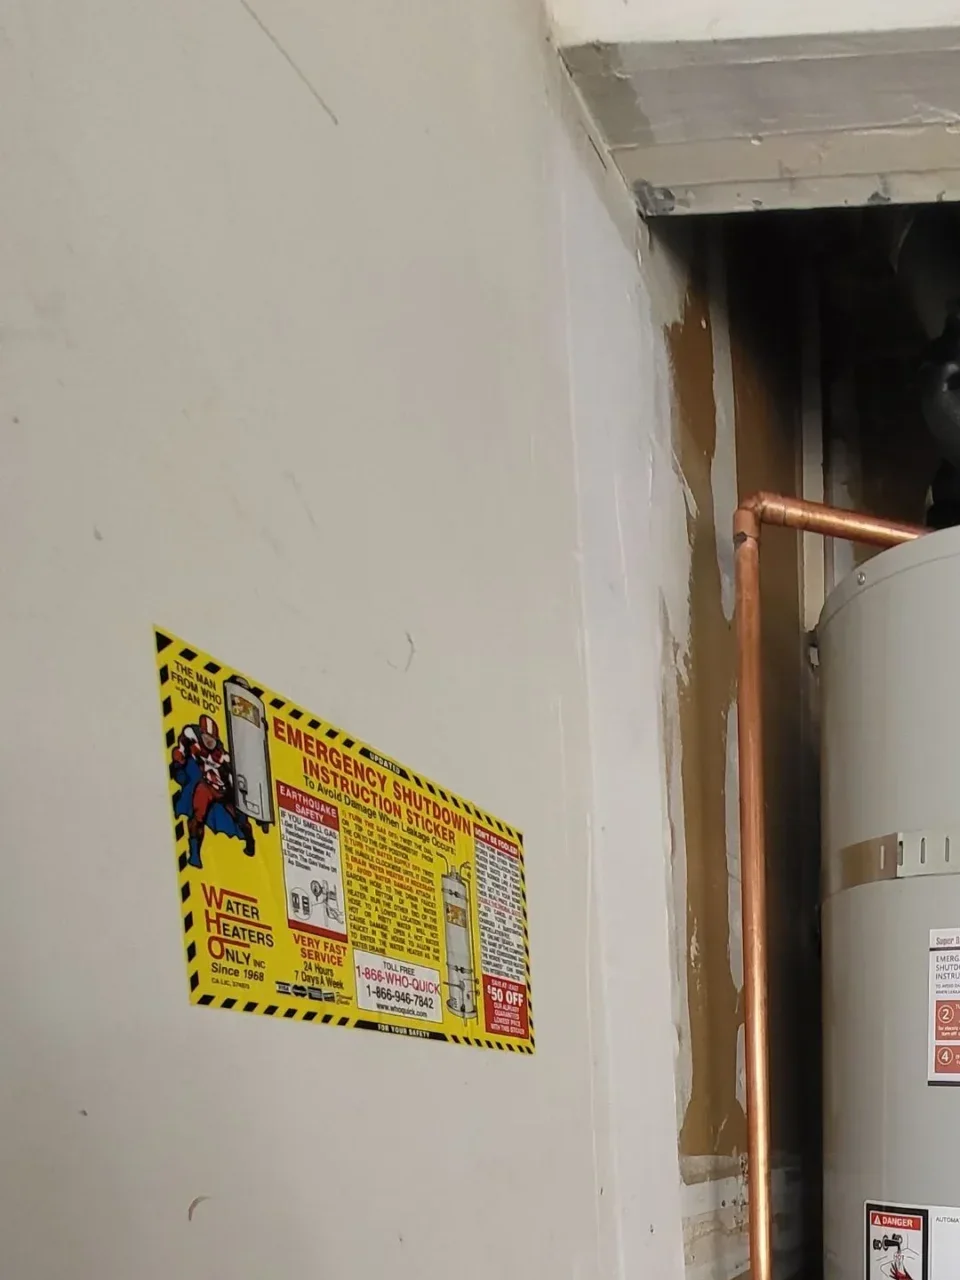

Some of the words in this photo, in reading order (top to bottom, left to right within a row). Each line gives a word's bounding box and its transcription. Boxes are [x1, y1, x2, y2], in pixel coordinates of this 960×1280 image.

[173, 660, 193, 679] THE
[196, 672, 216, 691] MAN
[171, 671, 198, 693] FROM
[200, 684, 222, 705] WHO
[369, 752, 400, 774] UPDATED
[273, 716, 387, 792] EMERGENCY
[392, 780, 472, 836] SHUTDOWN
[280, 785, 336, 818] EARTHQUAKE
[303, 756, 402, 819] INSTRUCTION
[406, 810, 456, 845] STICKER
[304, 774, 314, 789] To
[317, 782, 342, 801] Avoid
[344, 796, 377, 820] Damage
[379, 811, 400, 830] When
[402, 820, 430, 844] Leakage
[281, 810, 286, 818] IF
[288, 813, 301, 825] YOU
[303, 818, 322, 834] SMELL
[296, 803, 324, 822] SAFETY
[490, 836, 497, 845] BE
[200, 882, 260, 920] WATER
[204, 909, 274, 948] HEATERS
[207, 936, 250, 966] ONLY
[253, 958, 266, 968] INC
[292, 933, 320, 949] VERY
[324, 940, 348, 956] FAST
[936, 937, 954, 946] Super
[300, 948, 344, 967] SERVICE
[383, 961, 399, 972] TOLL
[400, 965, 415, 976] FREE
[212, 962, 239, 976] Since
[244, 968, 264, 982] 1968
[294, 970, 298, 980] 7
[302, 972, 320, 986] Days
[326, 976, 344, 989] Week
[304, 961, 312, 972] 24
[314, 962, 334, 977] Hours
[356, 965, 440, 995] 1-866-WHO-QUICK
[366, 984, 434, 1009] 1-866-946-7842
[488, 985, 503, 1002] $50
[506, 990, 523, 1007] OFF
[376, 1003, 427, 1017] www.whoquick.com
[942, 1009, 949, 1020] 2
[377, 1024, 389, 1032] FOR
[391, 1026, 407, 1034] YOUR
[409, 1029, 430, 1038] SAFETY
[941, 1050, 948, 1061] 4
[882, 1218, 913, 1228] DANGER
